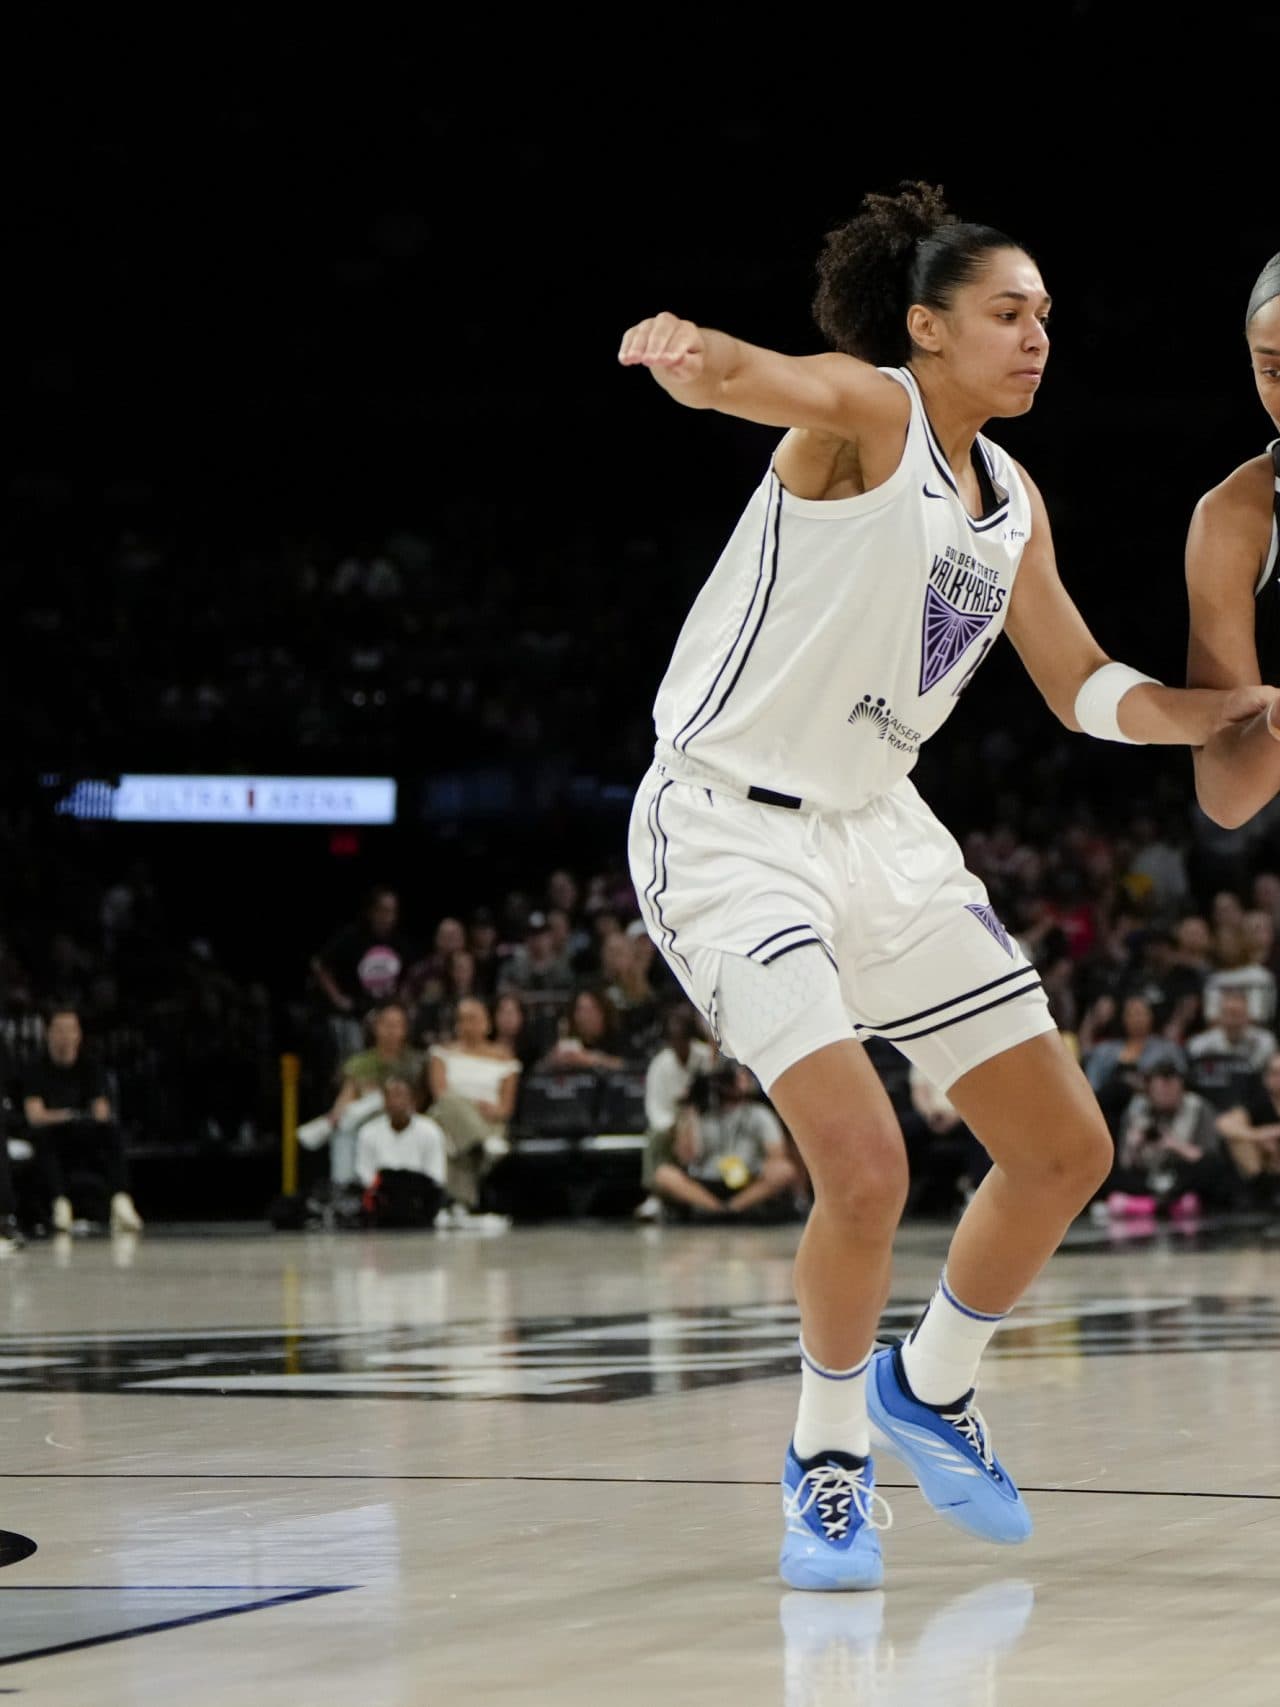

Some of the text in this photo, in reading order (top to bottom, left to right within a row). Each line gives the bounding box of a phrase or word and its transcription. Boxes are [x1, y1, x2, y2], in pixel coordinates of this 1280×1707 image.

[945, 545, 977, 571] GOLDEN
[929, 554, 1007, 613] VALKYRIES
[889, 715, 921, 742] AISER
